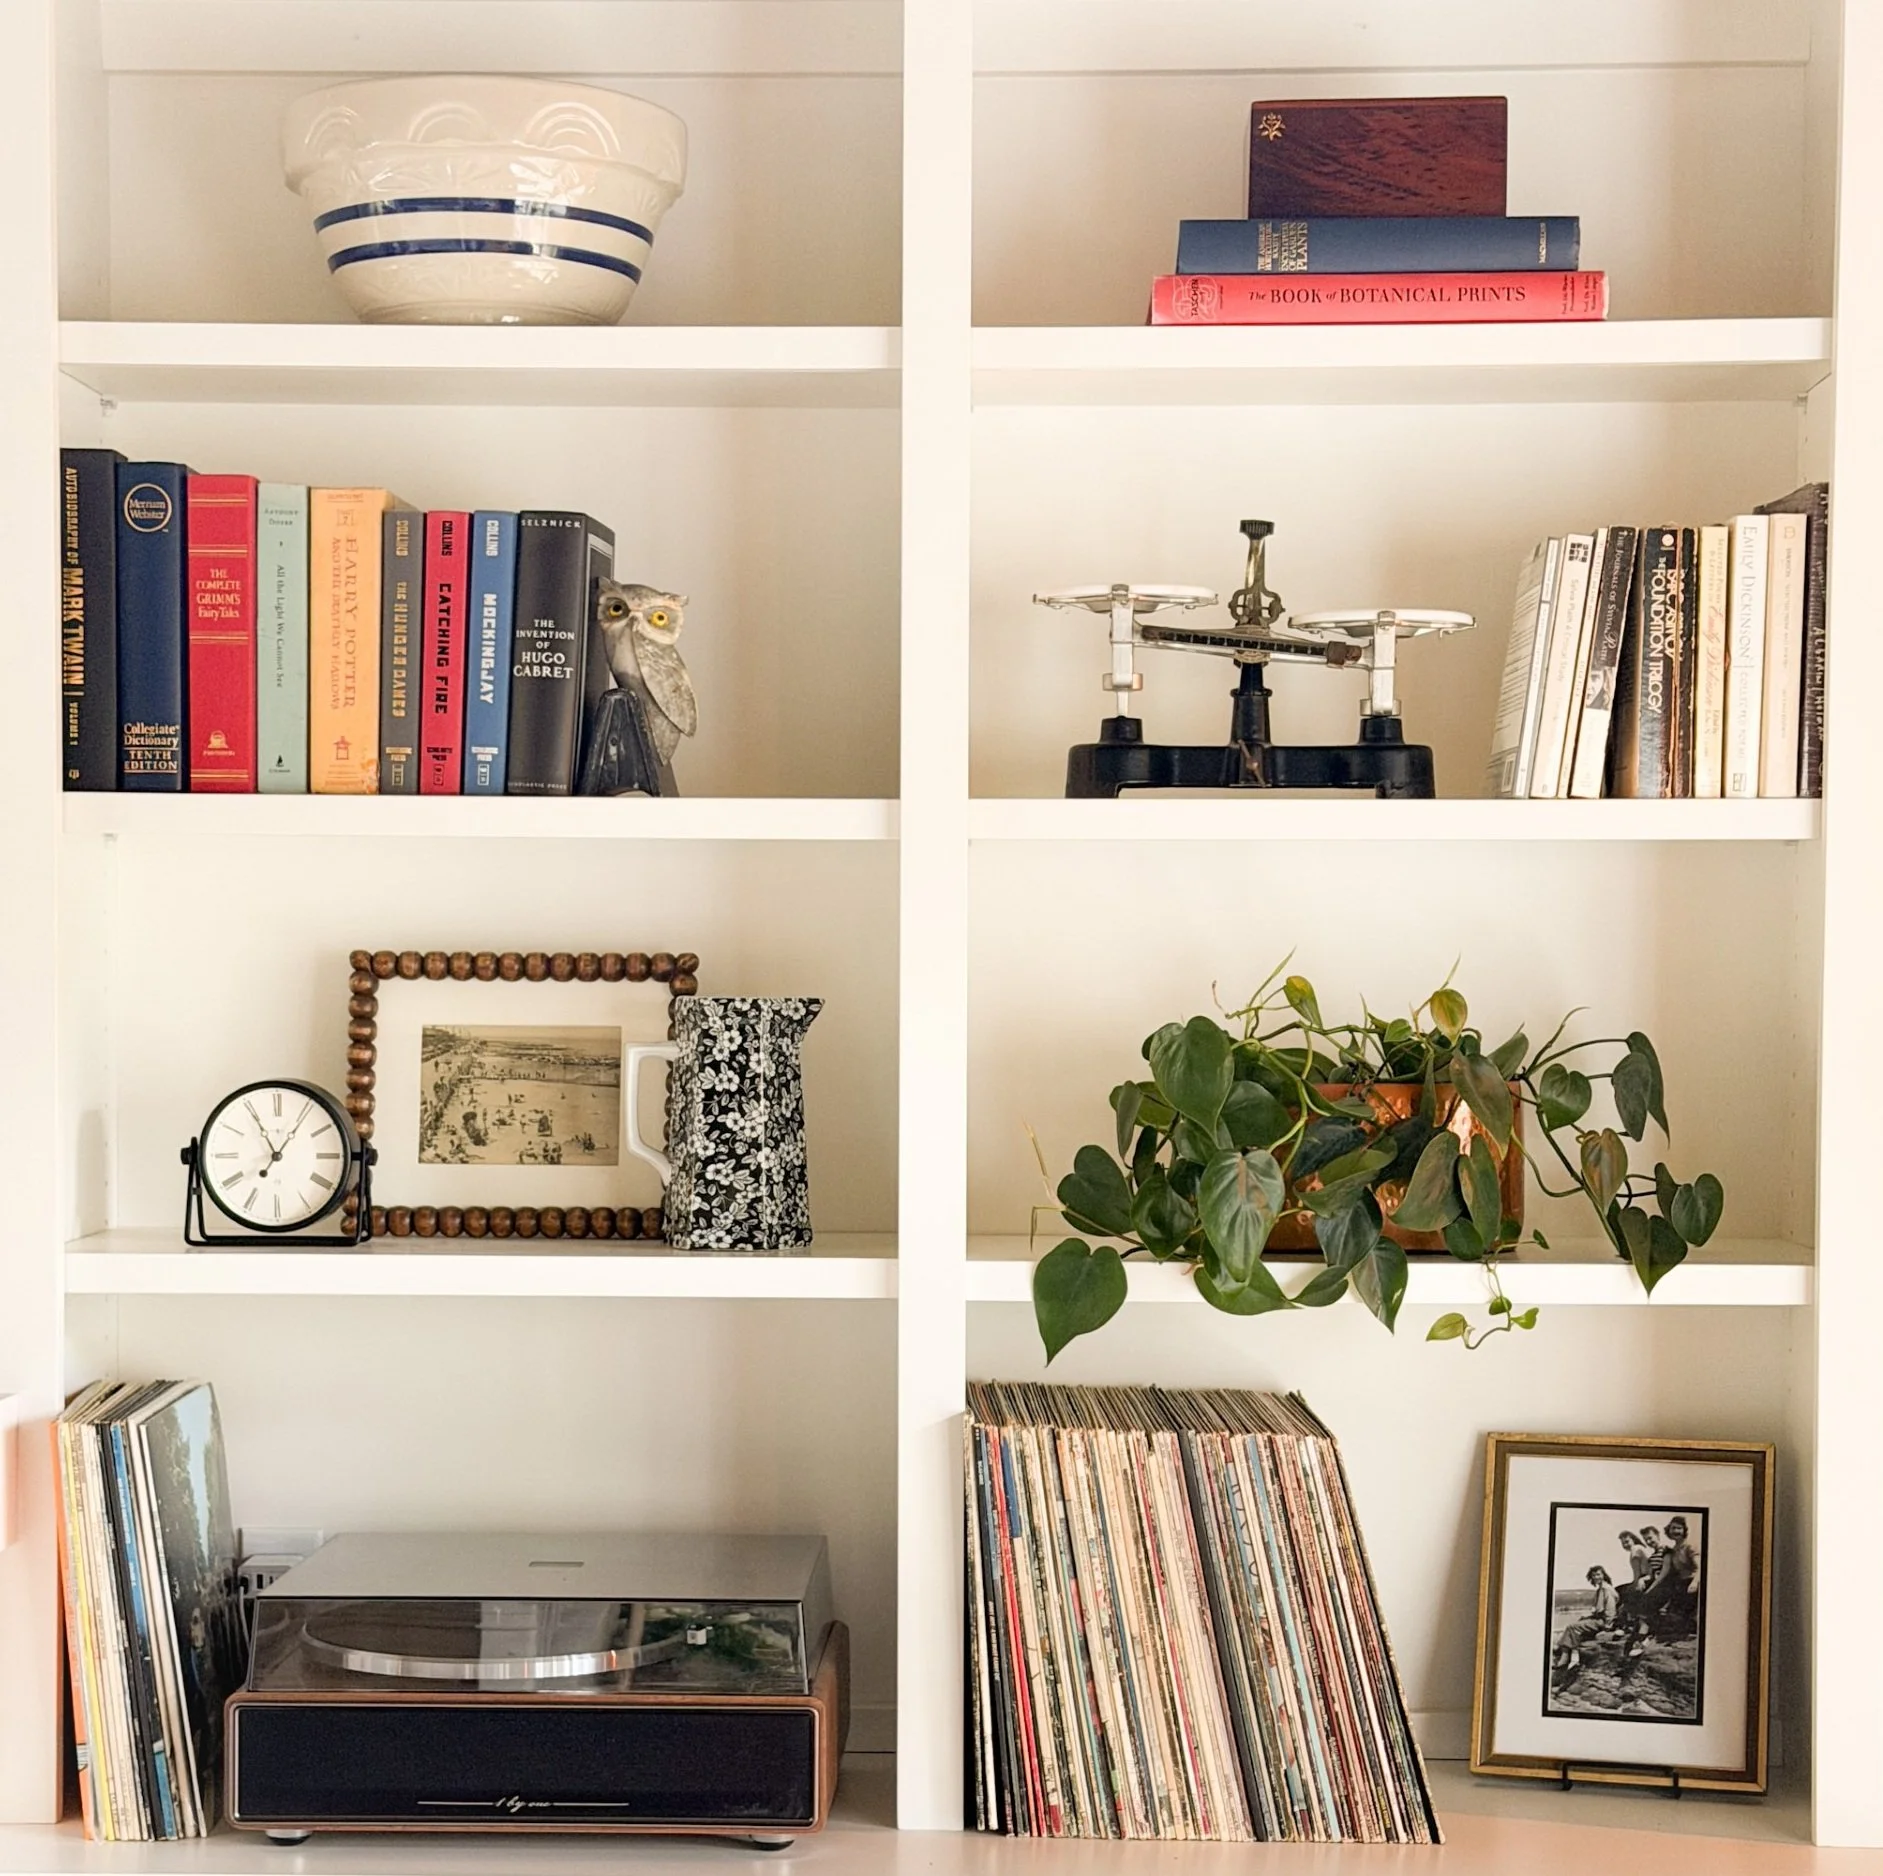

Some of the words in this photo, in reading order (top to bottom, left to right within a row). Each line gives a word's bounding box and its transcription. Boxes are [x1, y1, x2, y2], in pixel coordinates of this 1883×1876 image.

[1297, 222, 1308, 271] PLANTS
[1289, 260, 1297, 271] OF
[1190, 278, 1199, 317] TASCHEN
[1249, 291, 1266, 301] The
[1271, 288, 1322, 303] BOOK
[1326, 291, 1337, 300] of
[1340, 287, 1451, 303] BOTANICAL
[1458, 286, 1526, 302] PRINTS
[66, 467, 79, 549] AUTOBIOGRAPHY
[521, 519, 582, 529] SELZNICK
[395, 520, 409, 556] COLLINS
[441, 520, 453, 557] COLLINS
[485, 520, 499, 556] COLLINS
[1740, 526, 1758, 570] EMILY
[66, 551, 79, 565] OF
[277, 564, 286, 577] All
[1611, 548, 1625, 590] JOURNALS
[1657, 556, 1667, 571] THE
[196, 580, 241, 590] COMPLETE
[210, 568, 228, 579] THE
[277, 579, 285, 594] the
[344, 535, 359, 620] HARRY
[63, 567, 85, 622] MARK
[274, 596, 286, 619] Light
[198, 606, 219, 621] Fairy
[437, 583, 452, 668] CATCHING
[534, 619, 556, 629] THE
[1649, 568, 1666, 657] FOUNDATION
[1739, 576, 1757, 660] DICKINSON
[276, 622, 286, 635] We
[393, 603, 408, 665] HUNGER
[516, 630, 575, 641] INVENTION
[63, 625, 85, 685] TWAIN
[276, 638, 286, 670] Cannot
[479, 593, 497, 704] MOCKINGJAY
[521, 651, 566, 665] HUGO
[535, 641, 551, 650] OF
[276, 673, 285, 688] See
[343, 627, 357, 708] POTTER
[513, 665, 574, 679] CABRET
[392, 669, 407, 717] GAMES
[434, 676, 449, 714] FIRE
[1648, 658, 1664, 714] TRILOGY
[69, 702, 79, 738] VOLUME
[124, 735, 179, 747] Dictionary
[124, 761, 178, 770] EDITION
[130, 750, 172, 761] TENTH
[494, 1797, 506, 1807] 1
[506, 1795, 526, 1813] by
